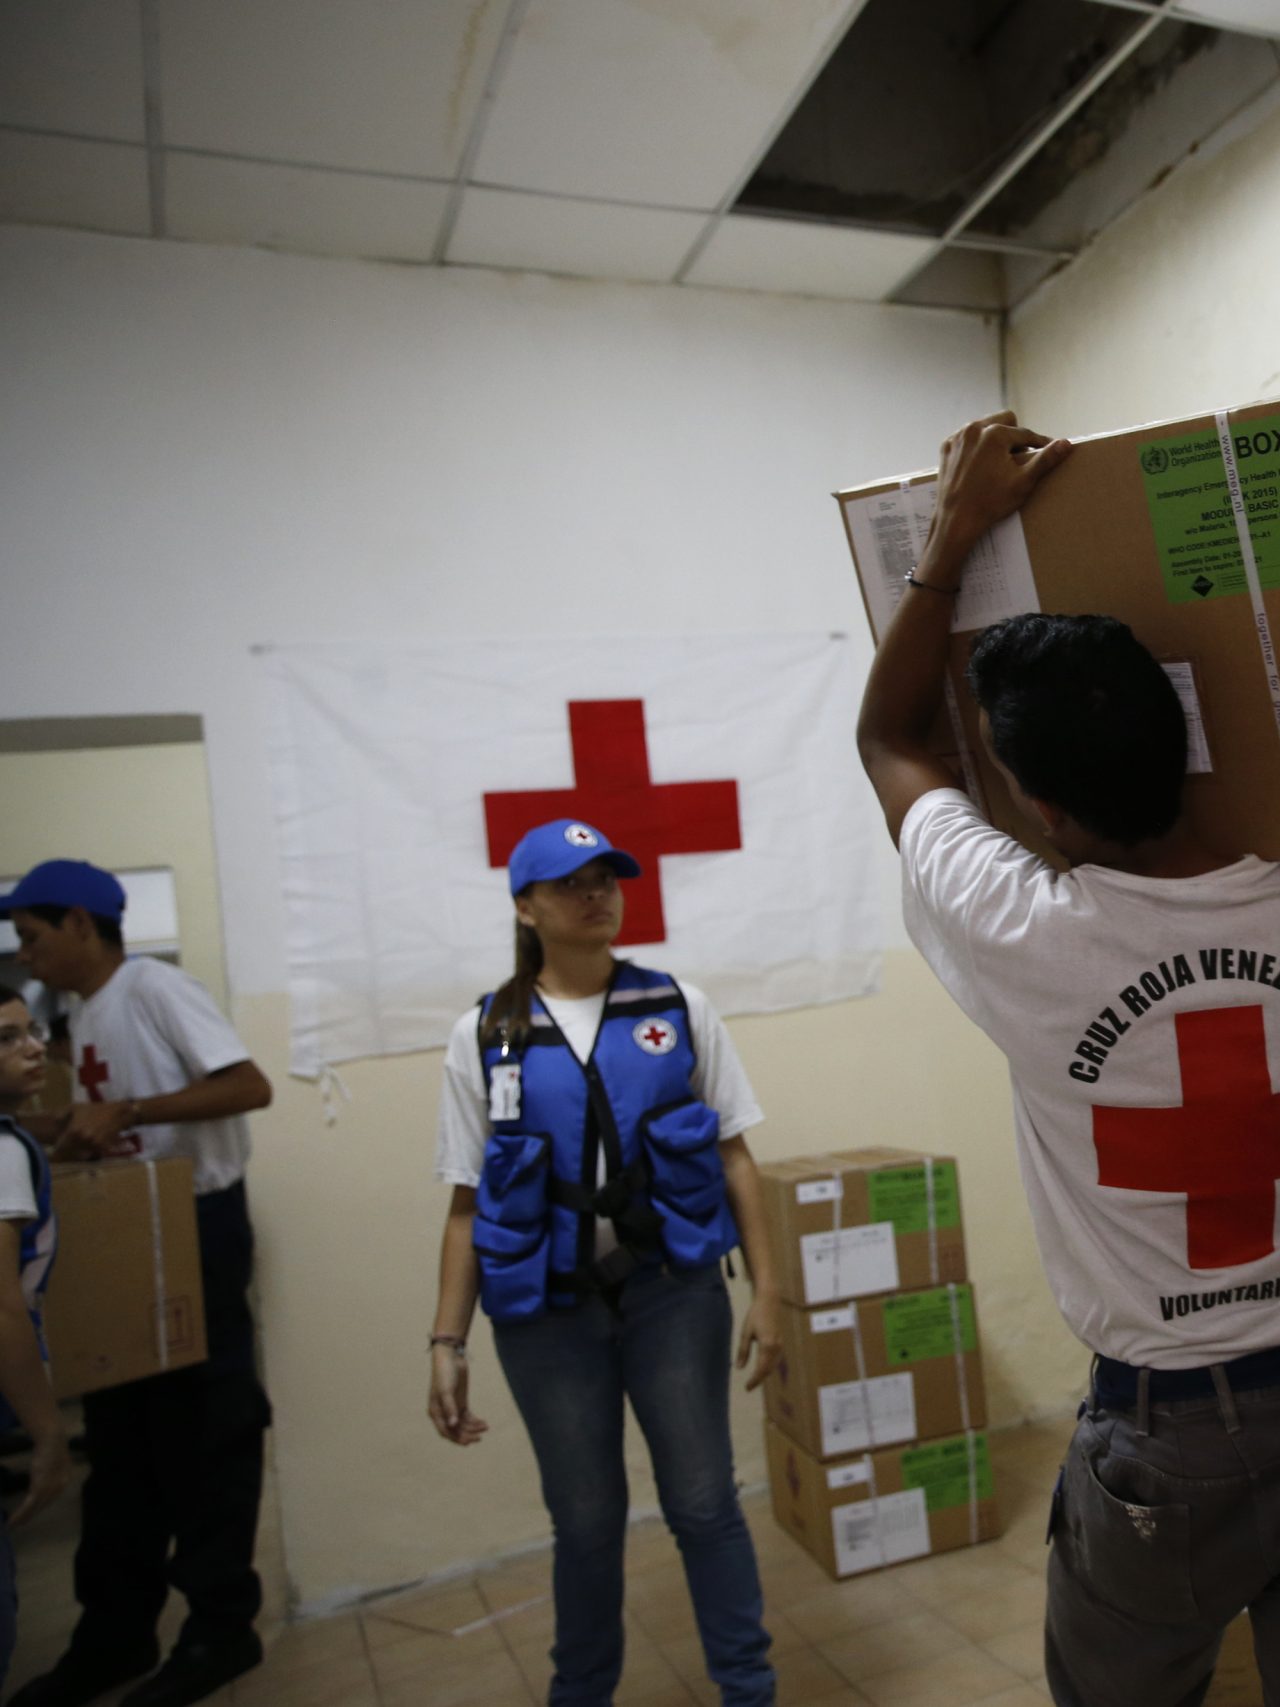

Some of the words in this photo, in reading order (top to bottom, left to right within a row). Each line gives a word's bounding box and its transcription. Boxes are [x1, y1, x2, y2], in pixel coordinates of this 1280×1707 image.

[1169, 443, 1192, 456] World
[1194, 438, 1220, 451] Health
[1171, 451, 1222, 468] Organization
[1156, 485, 1202, 500] Interagency
[1249, 470, 1277, 482] Health
[1221, 434, 1244, 513] www.meg.nl
[1252, 486, 1278, 499] 2015)
[1248, 499, 1279, 513] BASIC
[1257, 612, 1275, 666] together
[1269, 674, 1280, 692] for
[1068, 1006, 1132, 1084] CRUZ
[1118, 953, 1196, 1018] ROJA
